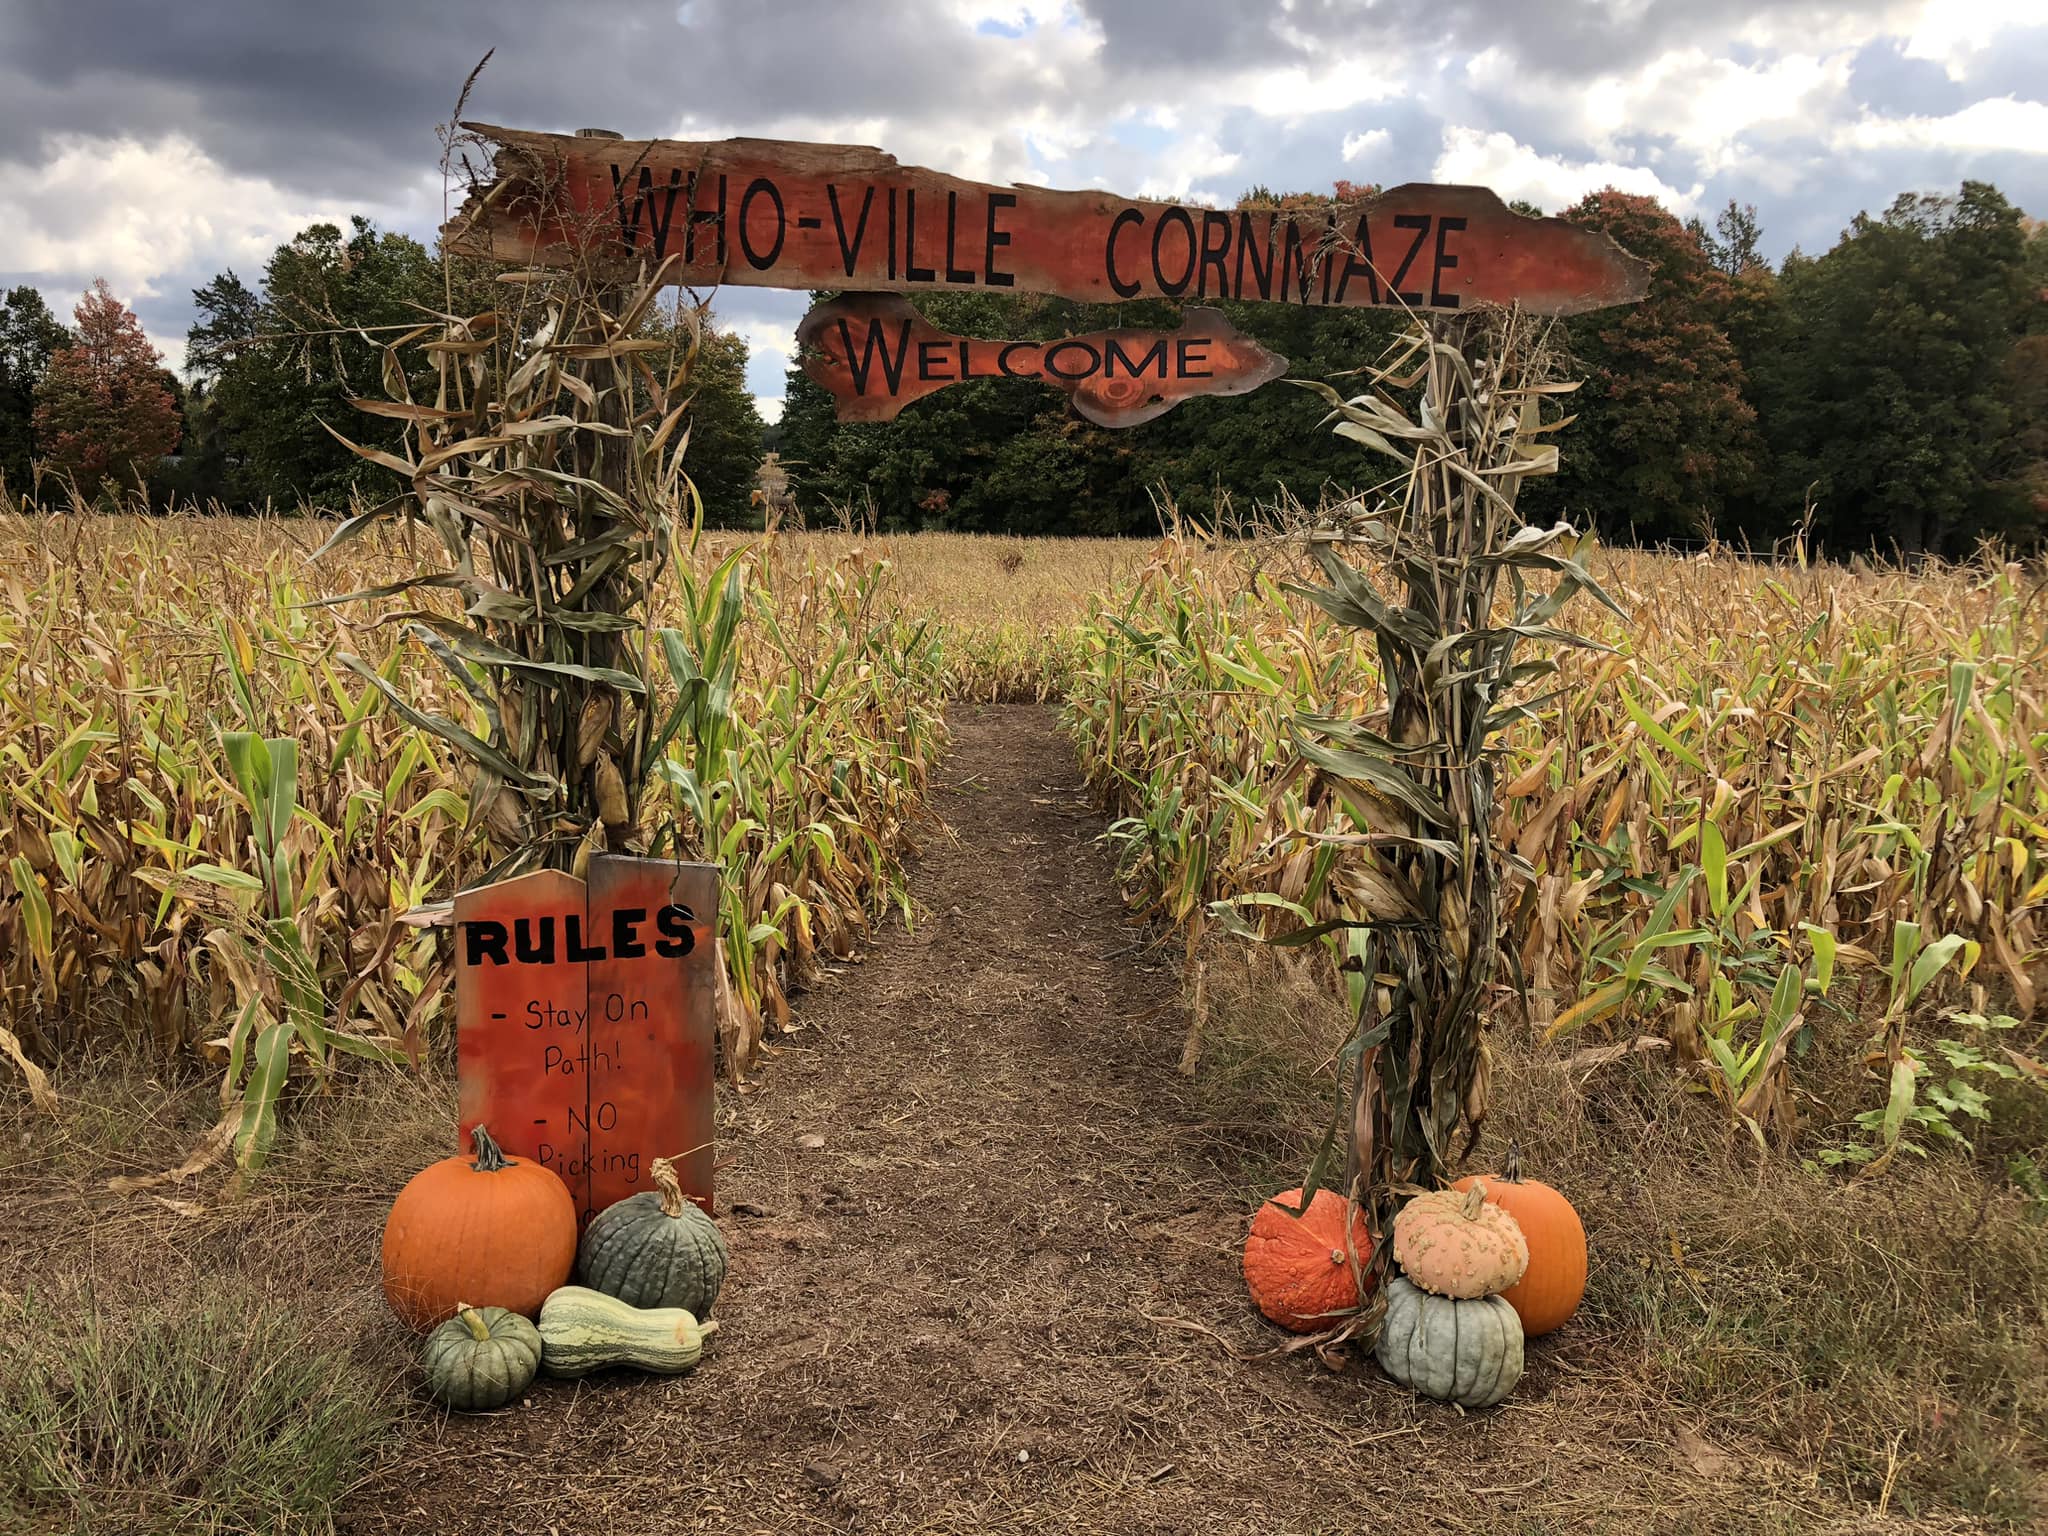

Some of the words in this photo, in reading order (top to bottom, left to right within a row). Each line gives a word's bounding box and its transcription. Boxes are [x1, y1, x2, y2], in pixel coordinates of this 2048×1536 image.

[610, 163, 1016, 286] WHO-VILLE
[1106, 208, 1467, 308] CORNMAZE
[837, 318, 1213, 397] WELCOME
[458, 904, 695, 966] RULES
[524, 1000, 588, 1035] Stay
[606, 993, 649, 1022] On
[545, 1041, 622, 1075] Path!
[568, 1102, 618, 1135] NO
[538, 1143, 640, 1184] Picking
